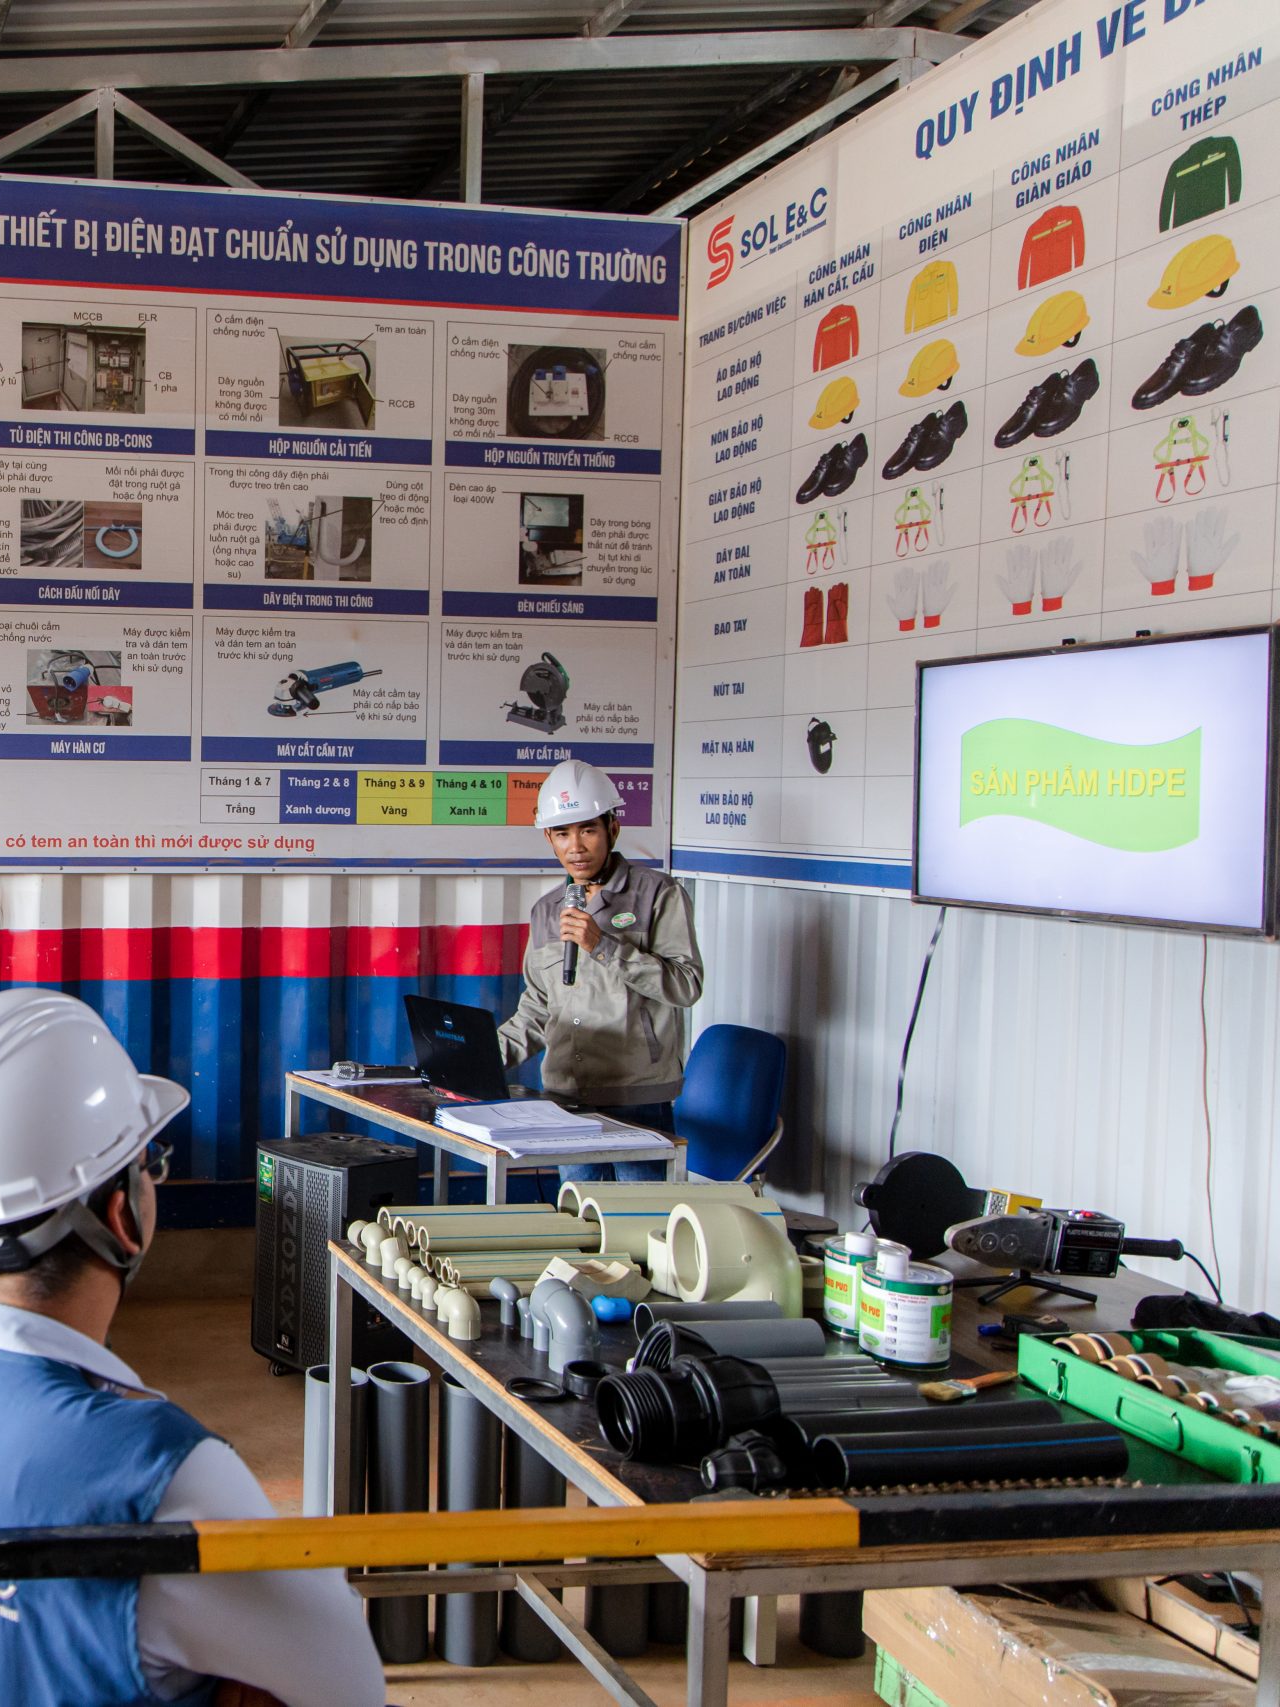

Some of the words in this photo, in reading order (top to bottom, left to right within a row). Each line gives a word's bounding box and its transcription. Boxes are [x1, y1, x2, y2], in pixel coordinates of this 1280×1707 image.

[1152, 79, 1200, 117] CÔNG
[1207, 47, 1262, 90] NHÂN
[916, 91, 979, 159] QUY
[990, 31, 1081, 119] ĐỊNH
[1181, 96, 1227, 131] THÉP
[1011, 153, 1051, 186] CÔNG
[1056, 129, 1099, 166] NHÂN
[1016, 180, 1051, 209] GIÀN
[1056, 160, 1092, 190] GIÁO
[741, 215, 778, 258] SOL
[786, 188, 827, 236] E&C
[899, 213, 932, 240] CÔNG
[936, 192, 971, 223] NHÂN
[919, 228, 948, 254] ĐIỆN
[75, 219, 98, 256] BỊ
[104, 220, 163, 259] ĐIỆN
[170, 224, 219, 262] ĐẠT
[226, 219, 308, 263] CHUẨN
[316, 227, 347, 265] SỬ
[354, 236, 417, 273] DỤNG
[424, 241, 501, 274] TRONG
[508, 242, 569, 279] CÔNG
[576, 248, 666, 284] TRƯỜNG
[809, 260, 836, 285] CÔNG
[840, 243, 870, 270] NHÂN
[804, 286, 824, 308] HÀN
[74, 312, 103, 321] MCCB
[138, 313, 157, 322] ELR
[750, 351, 761, 371] HỘ
[159, 371, 172, 380] CB
[717, 385, 732, 402] LAO
[735, 374, 759, 395] ĐỘNG
[26, 428, 52, 447] ĐIỆN
[54, 430, 72, 447] THI
[74, 429, 102, 447] CÔNG
[105, 432, 152, 449] DB-CONS
[714, 622, 730, 635] BAO
[733, 619, 747, 632] TAY
[714, 682, 730, 697] NÚT
[733, 682, 744, 695] TAI
[51, 740, 71, 754] MÁY
[73, 740, 91, 754] HÀN
[93, 742, 105, 754] CƠ
[722, 741, 733, 756] NẠ
[736, 738, 754, 752] HÀN
[209, 777, 241, 787] Tháng
[971, 765, 1018, 796] SẢN
[1107, 768, 1186, 797] HDPE
[226, 803, 255, 814] Trắng
[286, 805, 312, 814] Xanh
[315, 805, 351, 816] dương
[381, 806, 407, 816] Vàng
[450, 806, 475, 815] Xanh
[478, 806, 487, 815] lá
[6, 833, 26, 848] có
[31, 834, 62, 848] tem
[68, 837, 87, 848] an
[93, 833, 130, 848] toàn
[135, 834, 155, 848] thì
[161, 834, 193, 848] mới
[198, 835, 242, 849] được
[248, 835, 269, 848] sử
[274, 836, 314, 851] dụng
